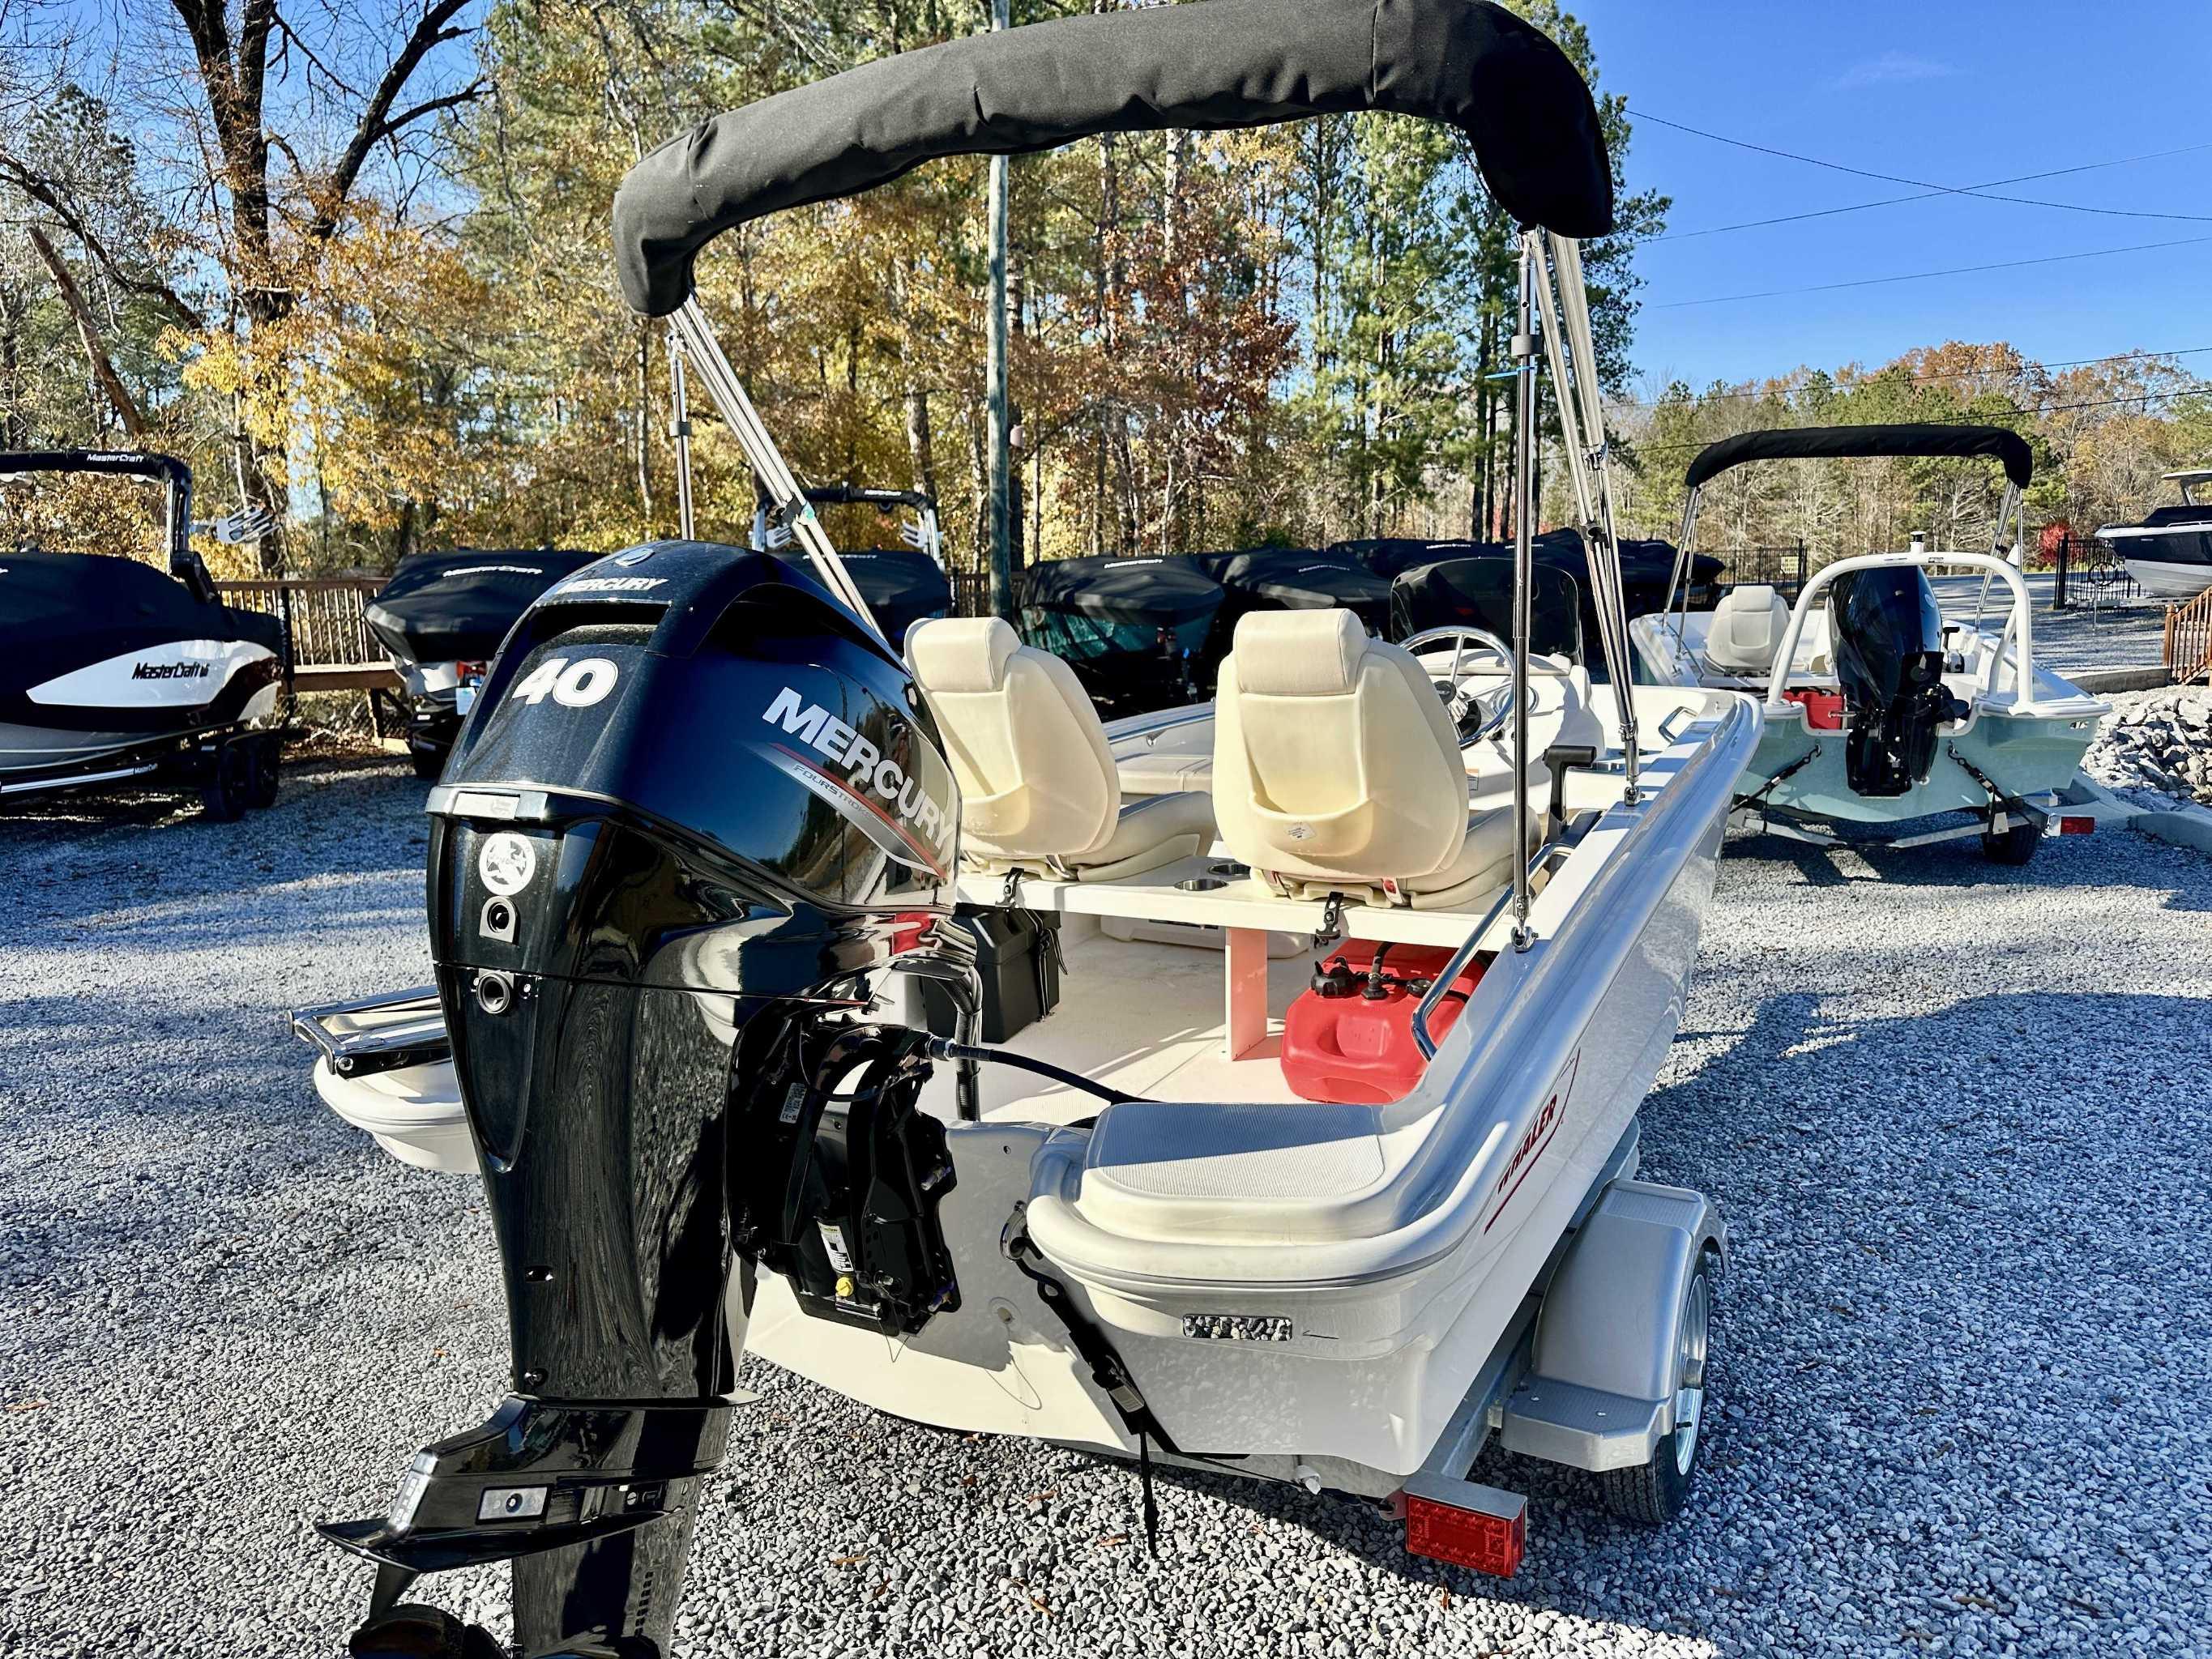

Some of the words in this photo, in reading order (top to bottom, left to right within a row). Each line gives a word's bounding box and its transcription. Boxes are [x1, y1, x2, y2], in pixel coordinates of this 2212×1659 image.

[87, 454, 144, 463] MasterCraft
[554, 577, 669, 595] MERCURY
[131, 661, 200, 680] MasterCraft
[511, 658, 618, 707] 40
[762, 686, 954, 850] MERCURY
